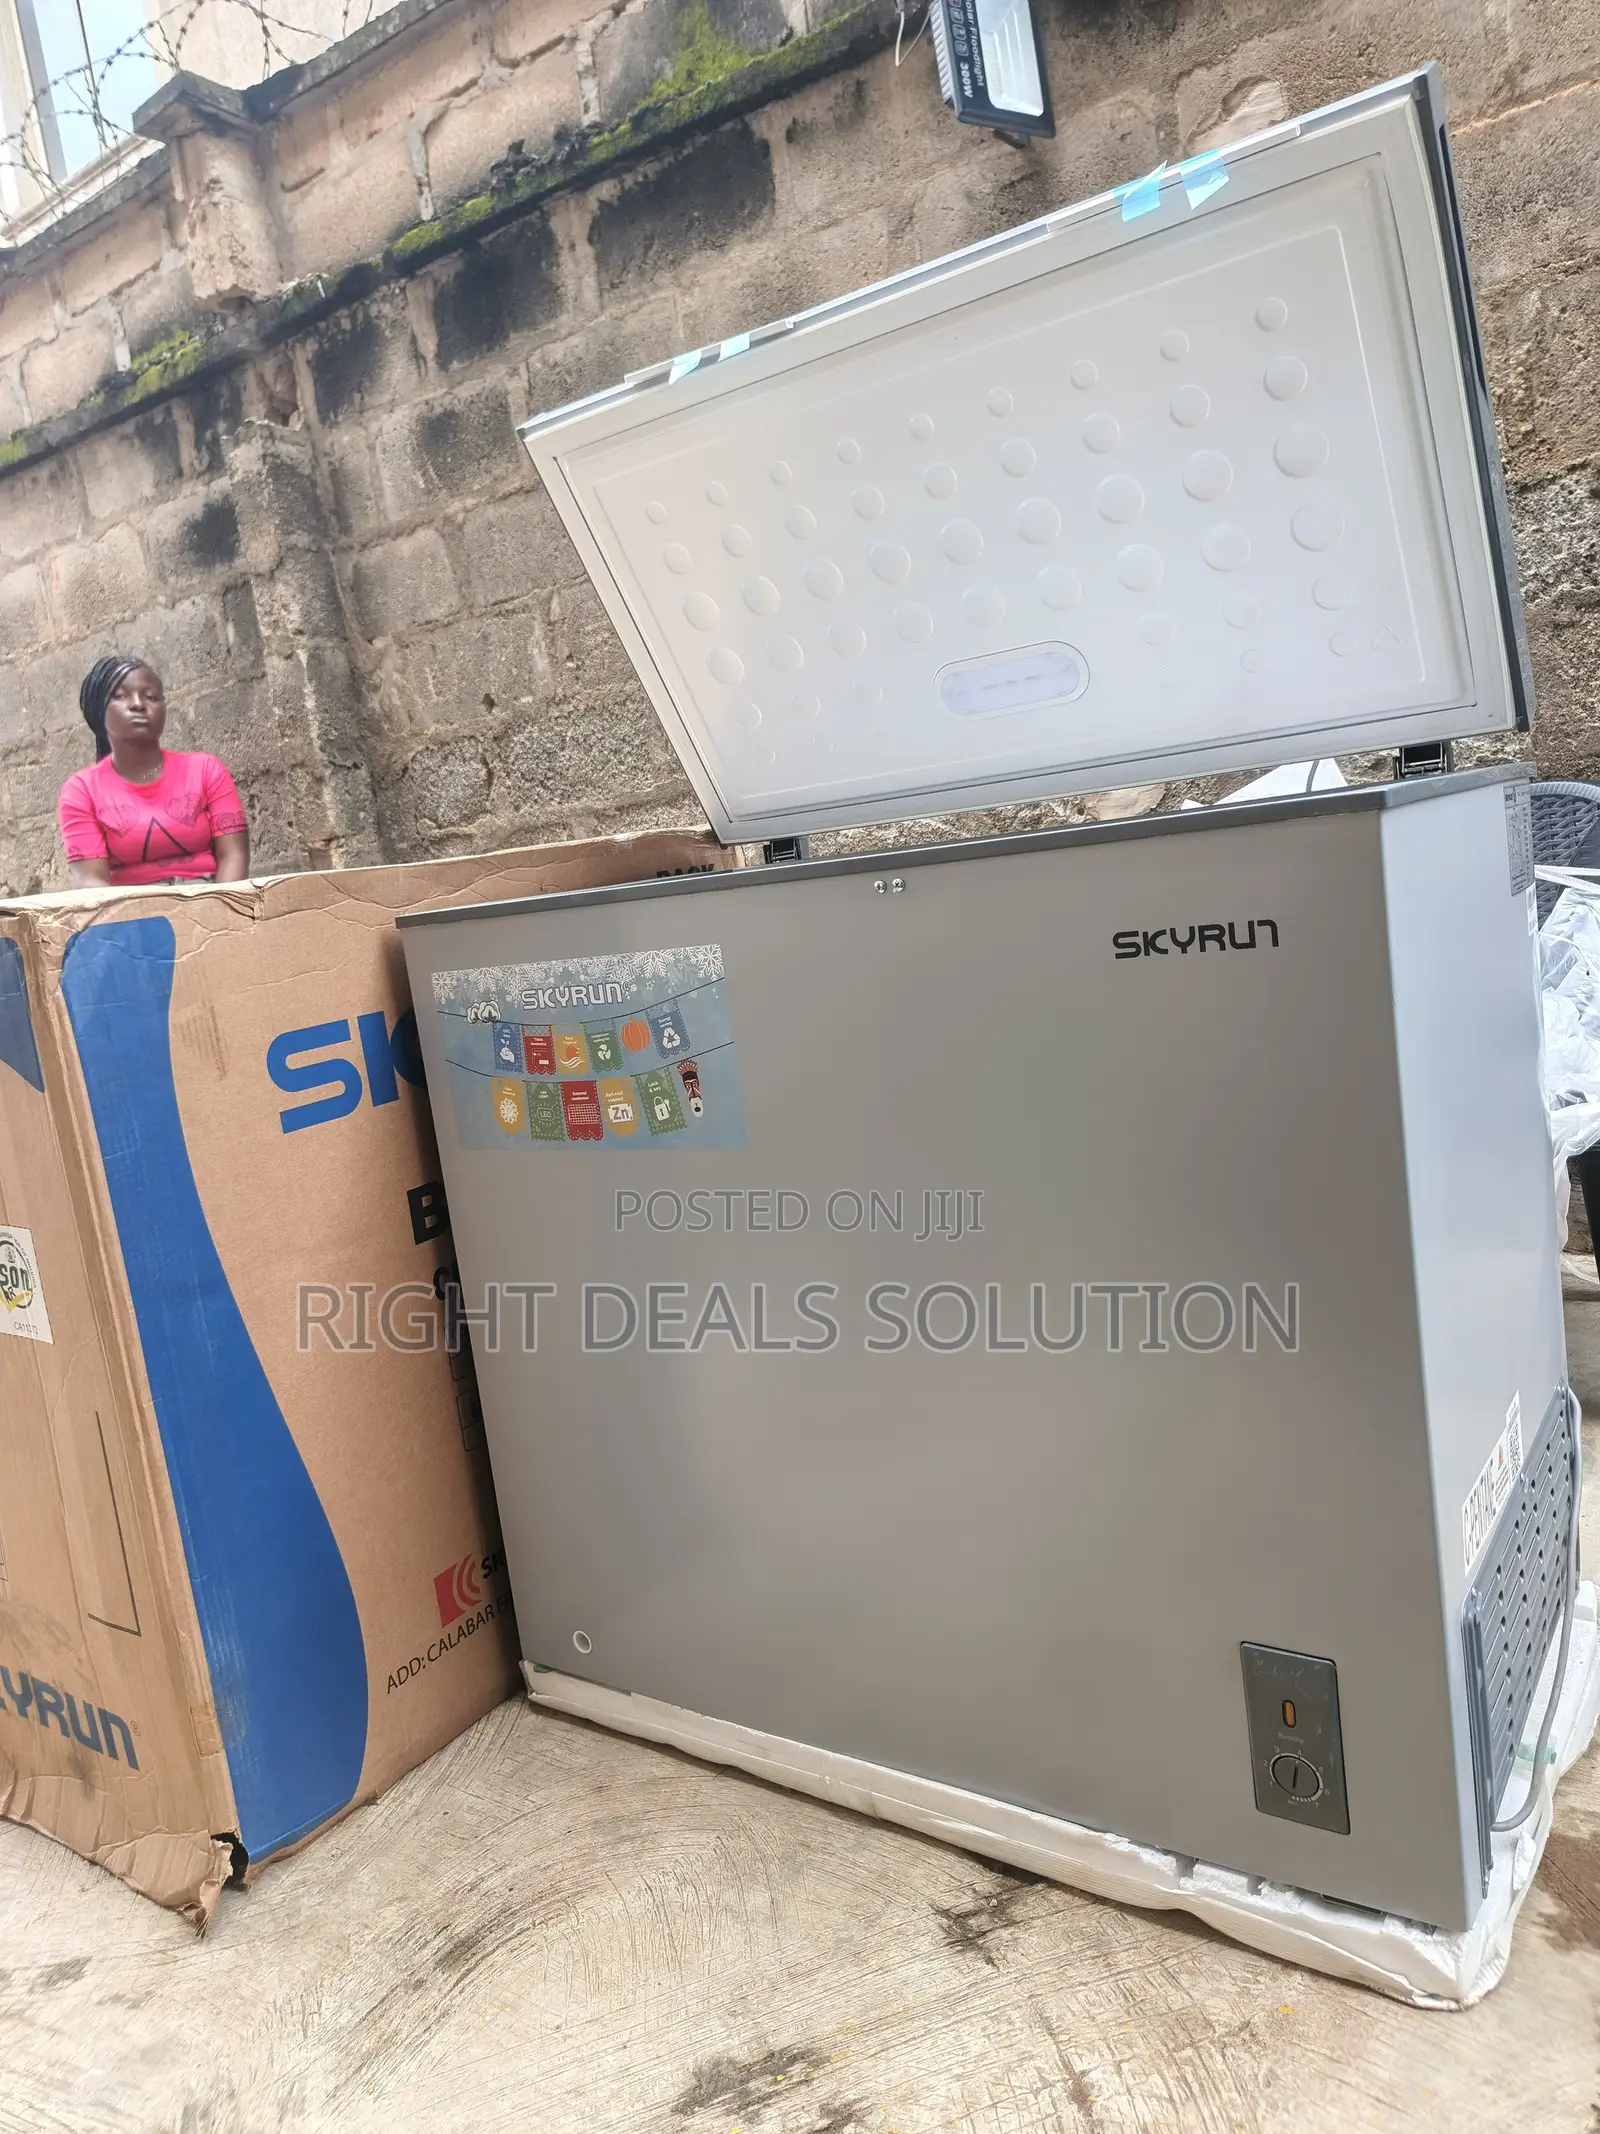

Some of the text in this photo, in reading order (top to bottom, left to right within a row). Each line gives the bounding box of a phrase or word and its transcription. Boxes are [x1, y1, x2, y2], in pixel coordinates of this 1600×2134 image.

[966, 0, 985, 87] olar Floodlight
[959, 62, 973, 98] 300W
[1112, 919, 1279, 959] SKYRUN
[521, 982, 623, 1010] SKYRUN
[612, 1106, 629, 1120] Zn
[0, 1665, 139, 1771] YRUN
